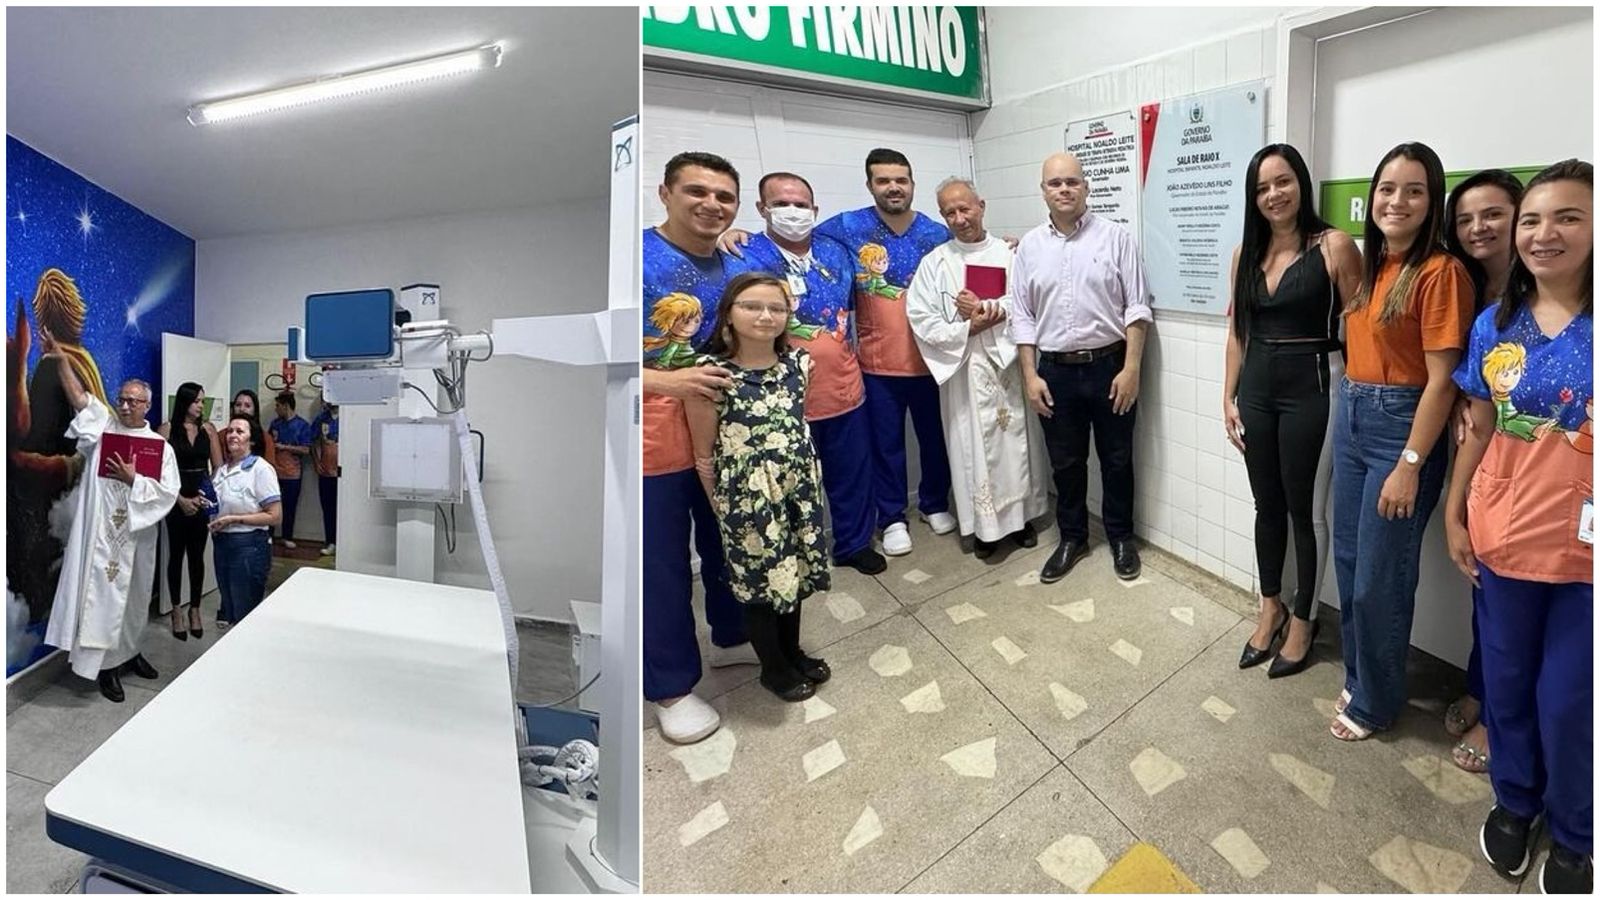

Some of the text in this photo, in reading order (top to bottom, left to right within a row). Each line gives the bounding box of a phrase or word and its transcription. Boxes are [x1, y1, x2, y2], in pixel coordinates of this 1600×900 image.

[1183, 125, 1210, 137] GOVERNO
[1068, 135, 1134, 152] HOSPITAL NOALDO LEITE
[1177, 152, 1220, 165] SALA DE RAIO X
[1093, 167, 1114, 176] CUNHA
[1115, 165, 1130, 173] LIMA
[1216, 179, 1232, 187] FILHO
